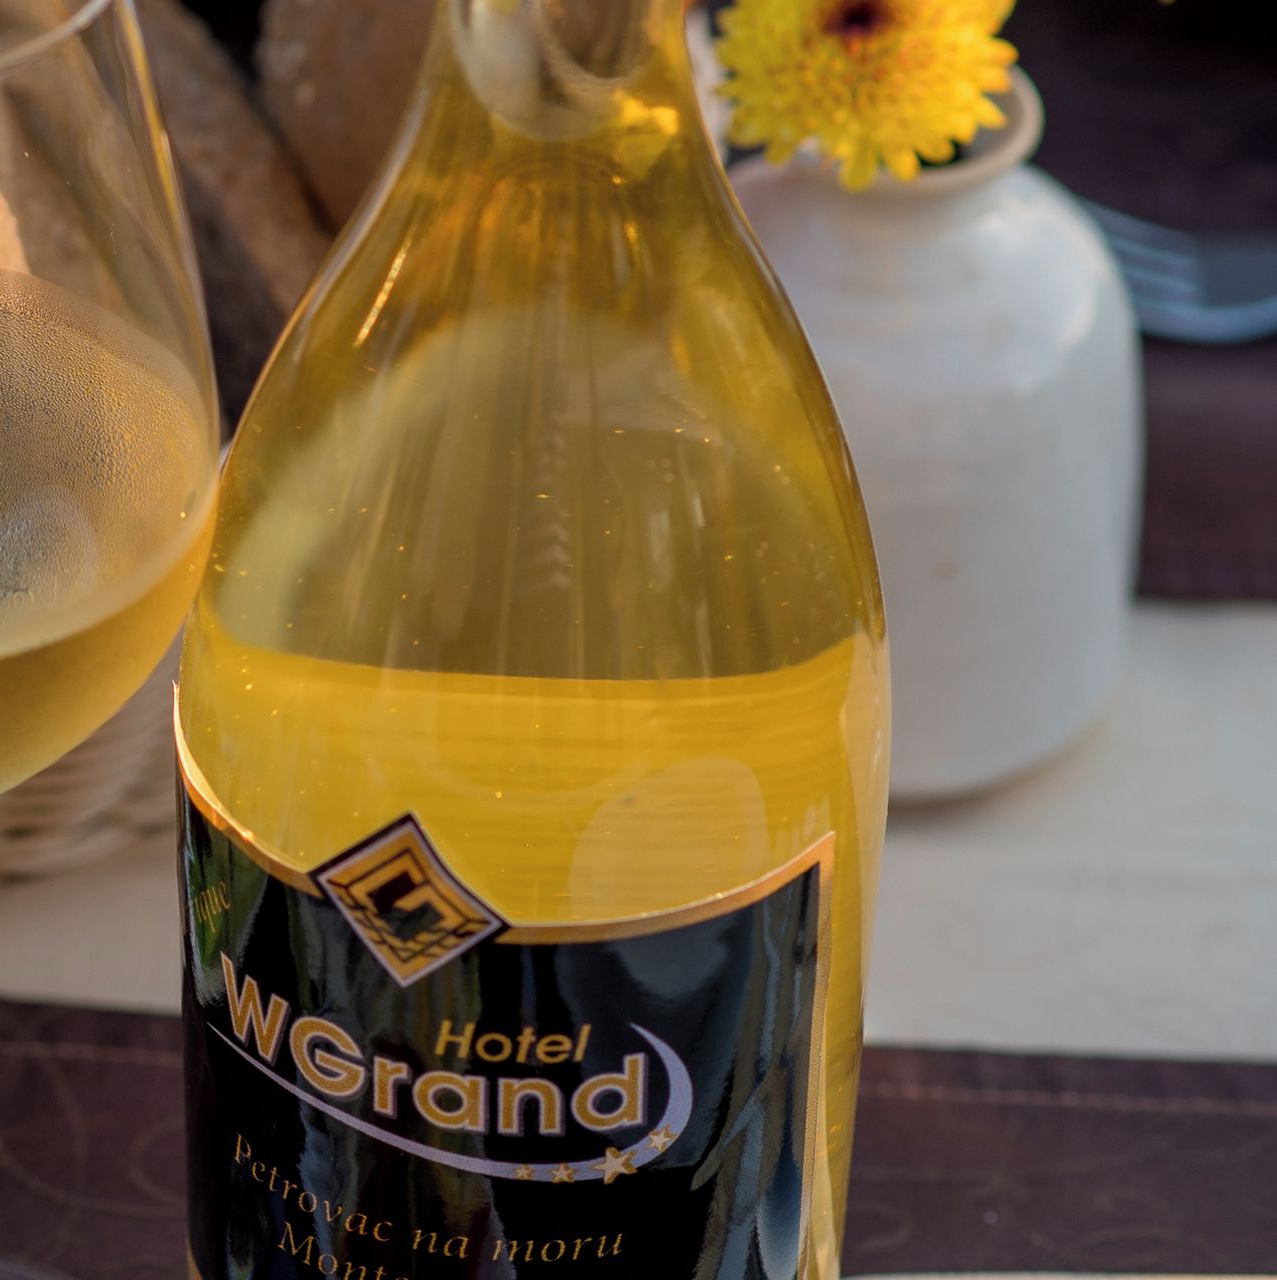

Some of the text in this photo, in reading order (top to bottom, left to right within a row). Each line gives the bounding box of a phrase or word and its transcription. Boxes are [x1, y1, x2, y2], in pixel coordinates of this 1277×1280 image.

[192, 880, 231, 933] ique
[435, 1020, 591, 1064] Hotel
[234, 1132, 622, 1262] Petrovac na moru
